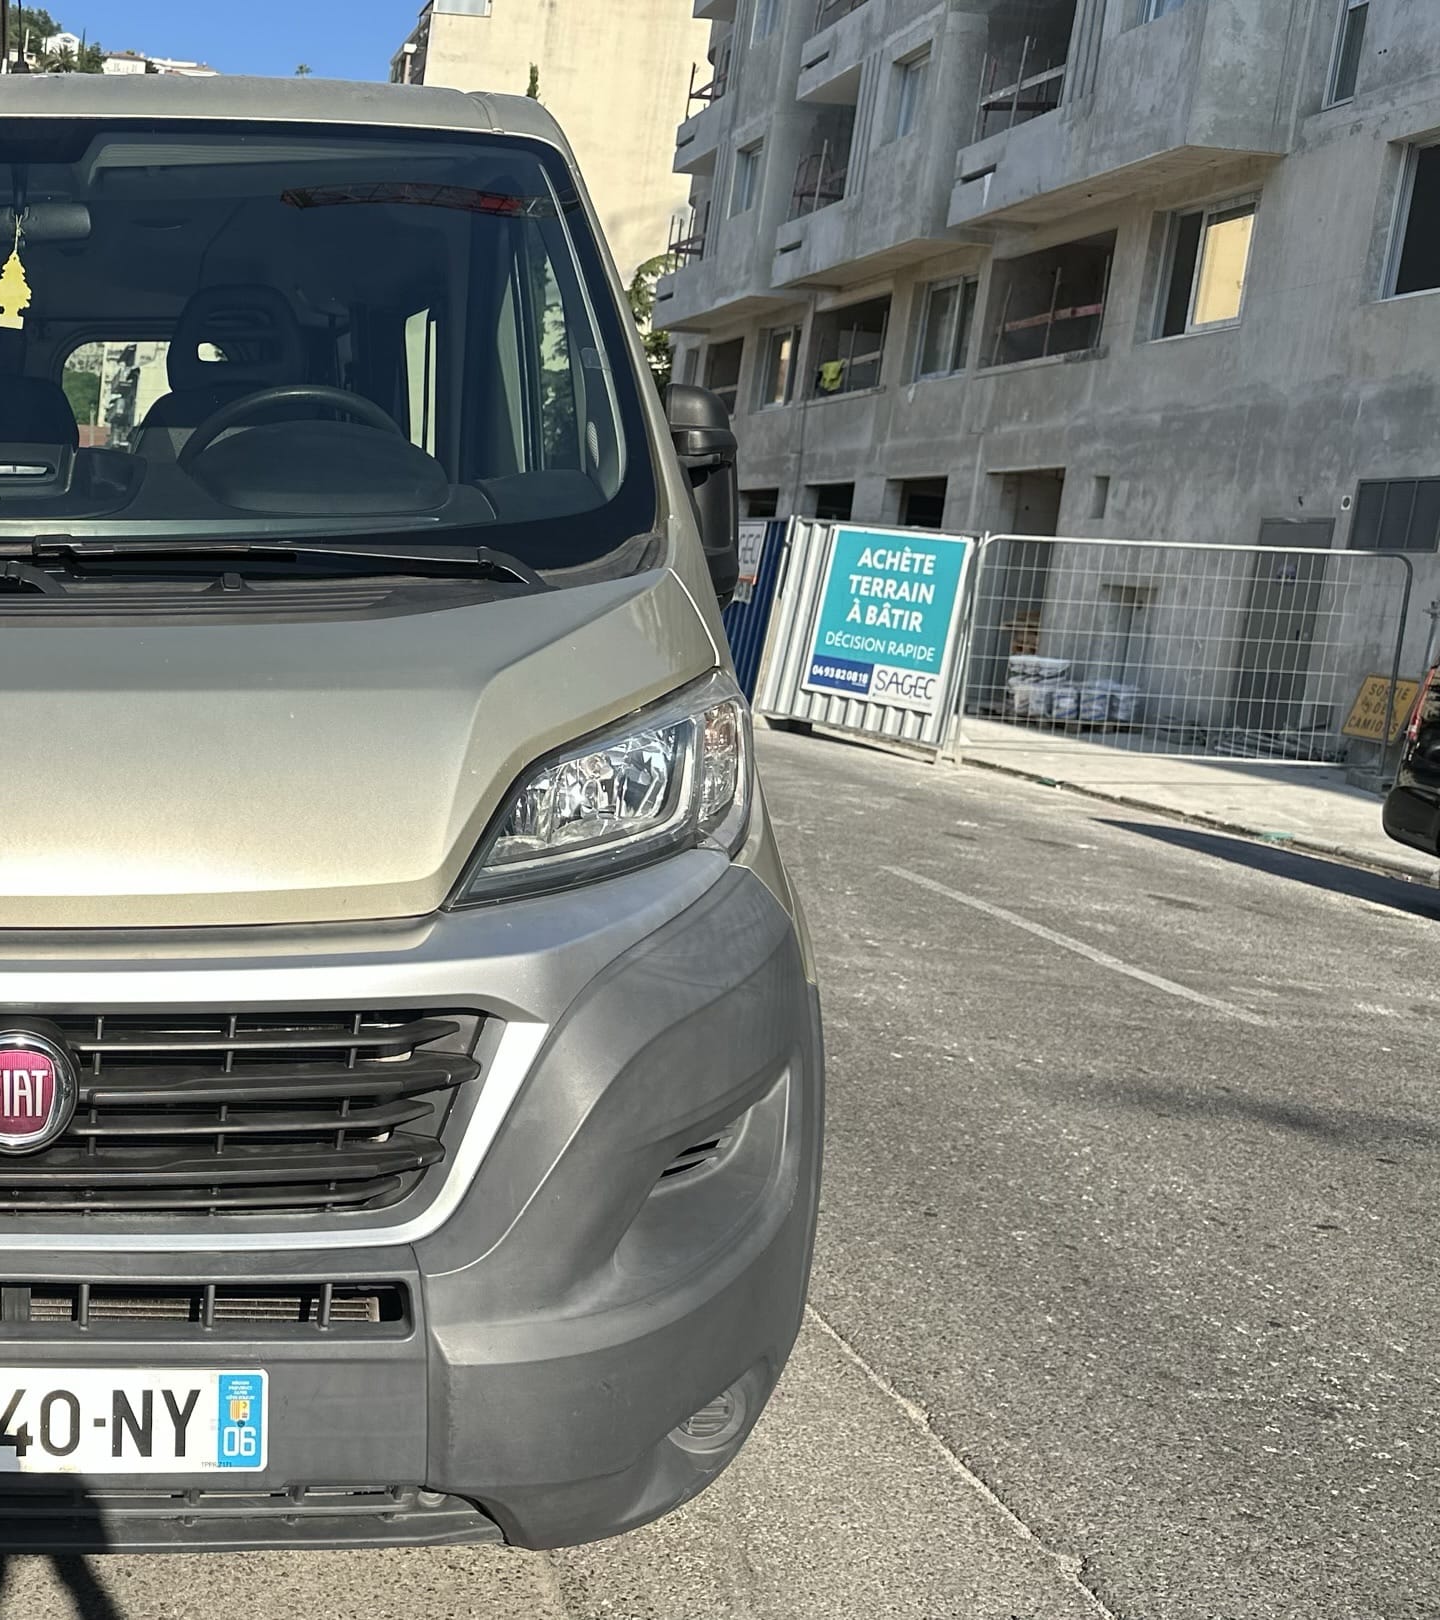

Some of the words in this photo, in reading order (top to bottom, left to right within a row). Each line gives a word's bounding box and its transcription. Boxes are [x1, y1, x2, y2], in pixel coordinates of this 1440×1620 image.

[857, 546, 937, 575] ACHÈTE
[849, 574, 935, 605] TERRAIN
[846, 597, 862, 624] À
[864, 601, 923, 633] BÂTIR
[825, 630, 887, 653] DÉCISION
[887, 641, 936, 662] RAPIDE
[875, 669, 936, 700] SAGEC
[1347, 715, 1399, 735] CAMIOS
[223, 1426, 257, 1457] 06
